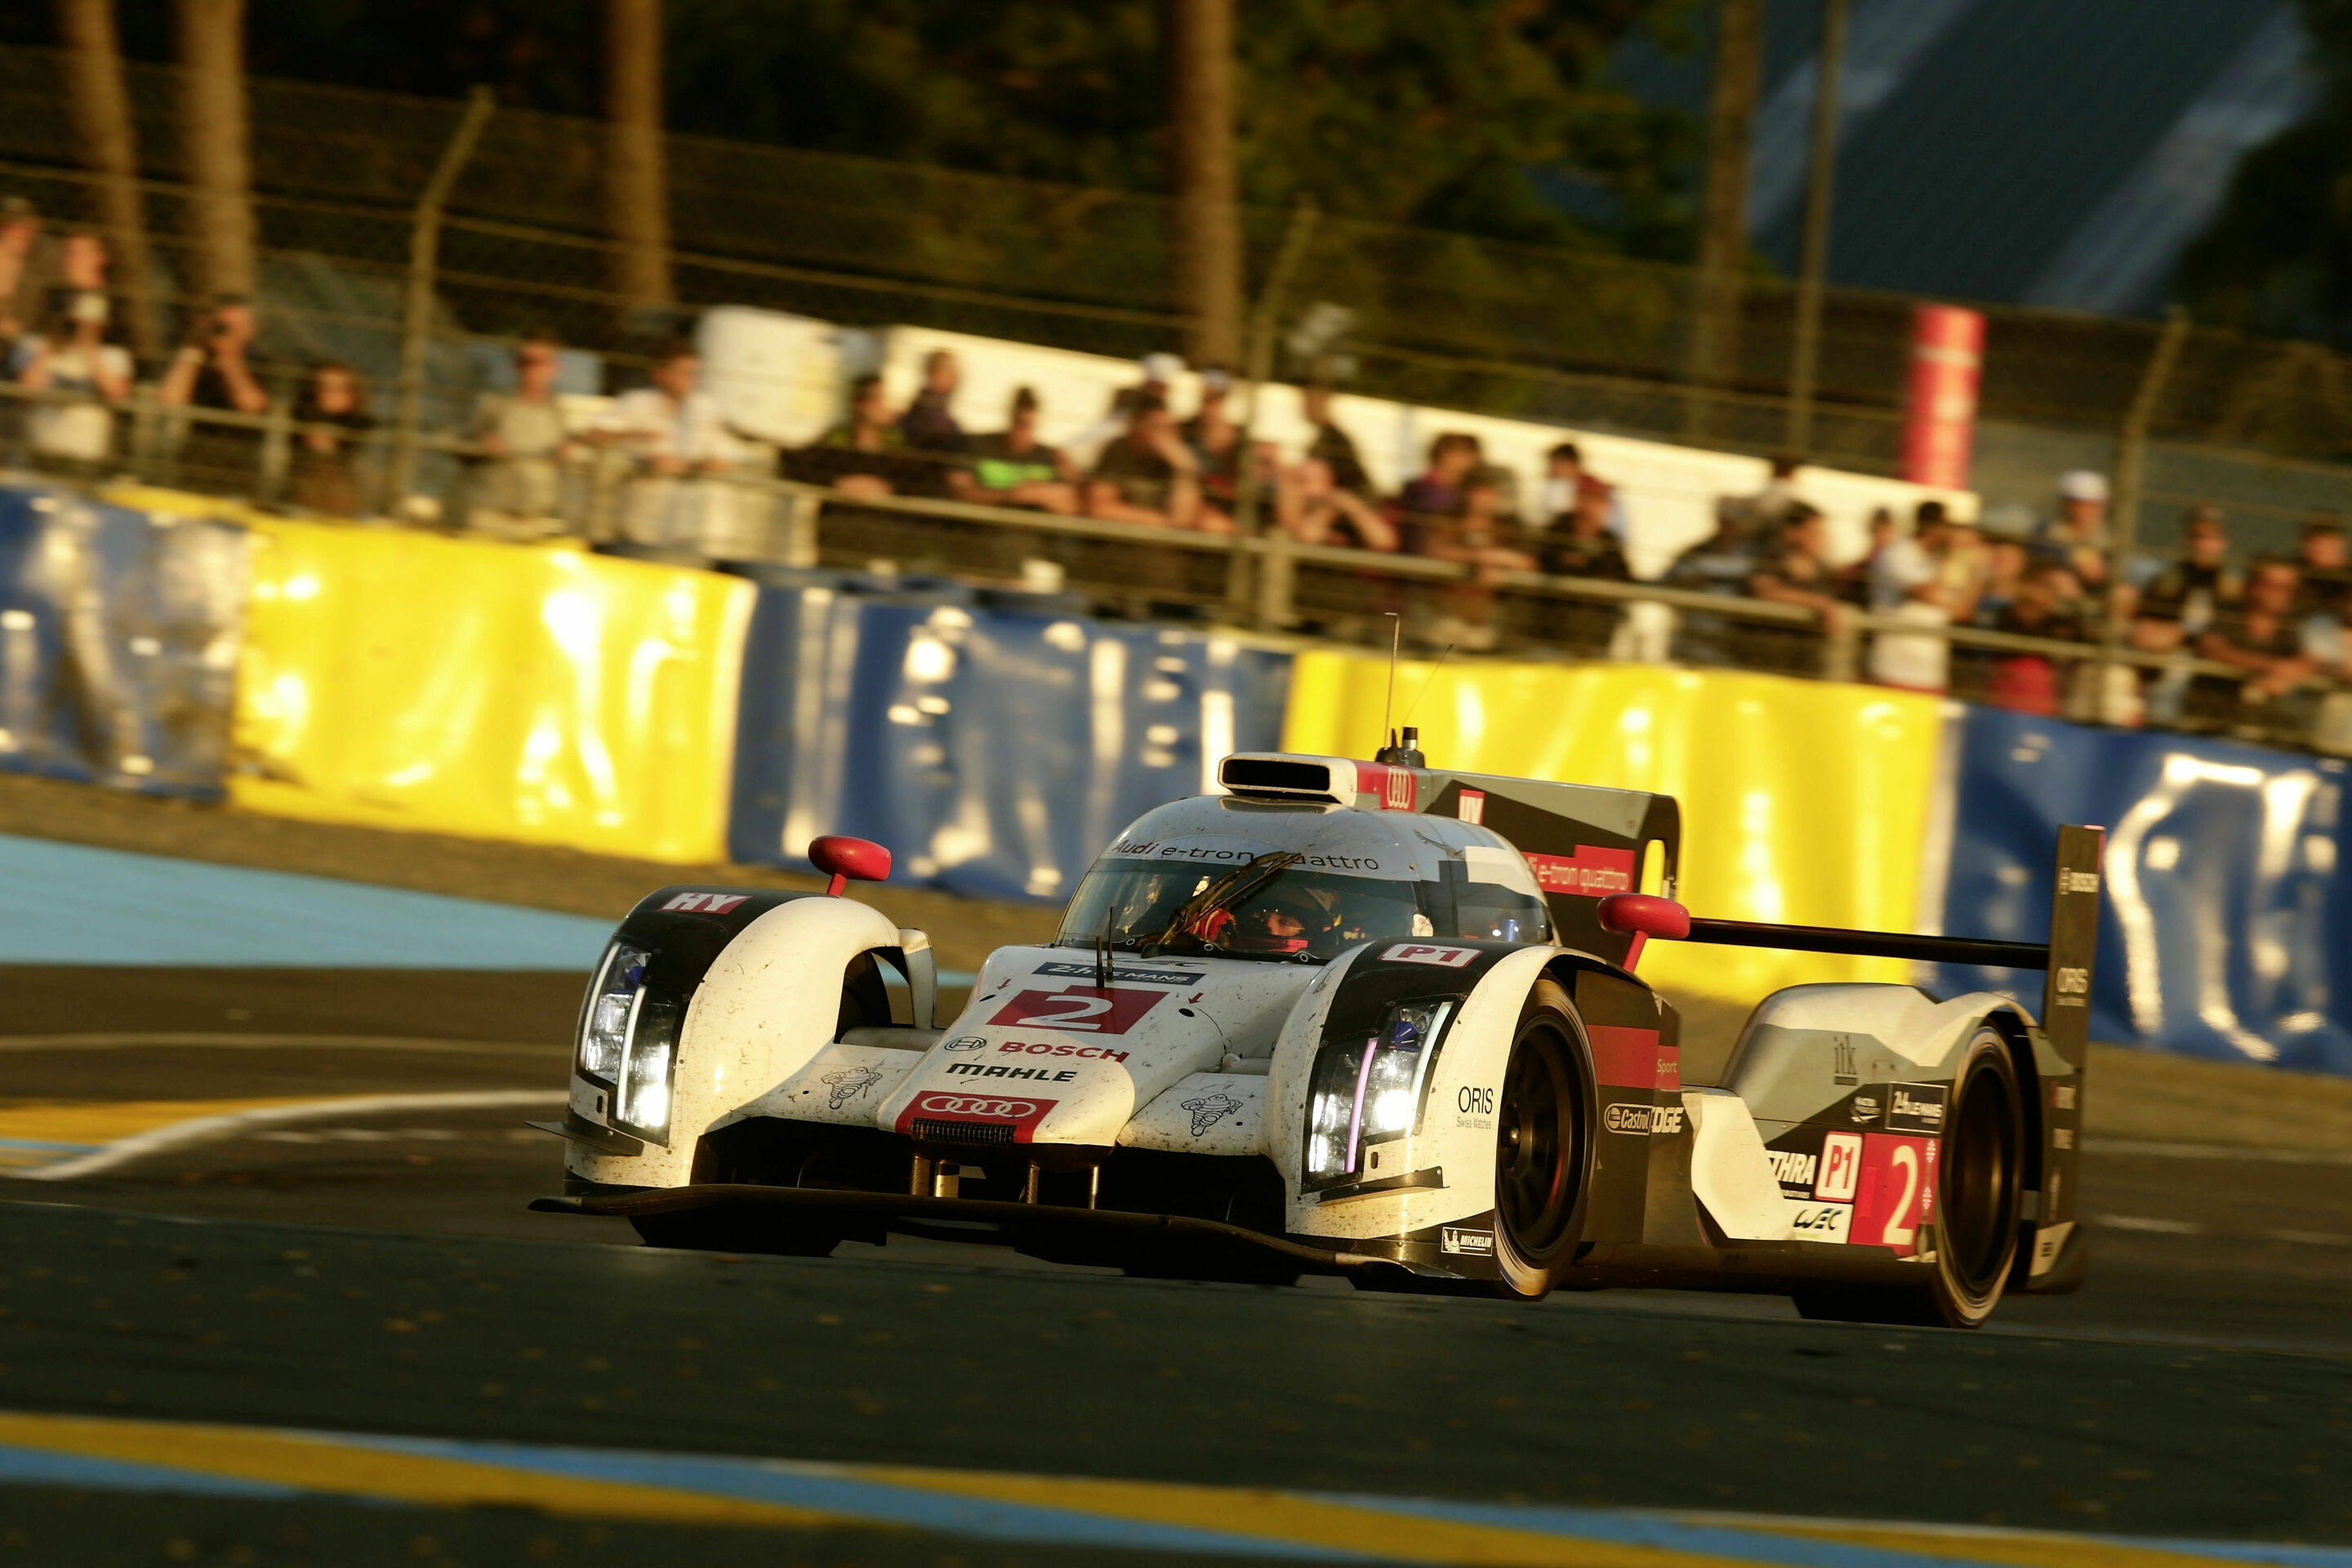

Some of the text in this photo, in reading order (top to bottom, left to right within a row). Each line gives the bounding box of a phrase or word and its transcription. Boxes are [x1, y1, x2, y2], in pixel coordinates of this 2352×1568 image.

[1111, 840, 1379, 871] Audi e-tron uattro
[662, 892, 748, 911] HY
[1396, 947, 1463, 962] P1
[1125, 973, 1189, 981] MANS
[1016, 996, 1113, 1030] 2
[998, 1041, 1130, 1062] BOSCH
[946, 1063, 1077, 1082] MAHLE
[1657, 1058, 1677, 1075] Sport
[1458, 1086, 1494, 1115] ORIS
[1457, 1116, 1472, 1129] Swiss
[1620, 1107, 1684, 1133] Castrol DGE
[1824, 1145, 1854, 1190] P1
[1882, 1145, 1918, 1245] 2
[1793, 1208, 1843, 1231] WEC
[1460, 1235, 1492, 1248] MICHELIN
